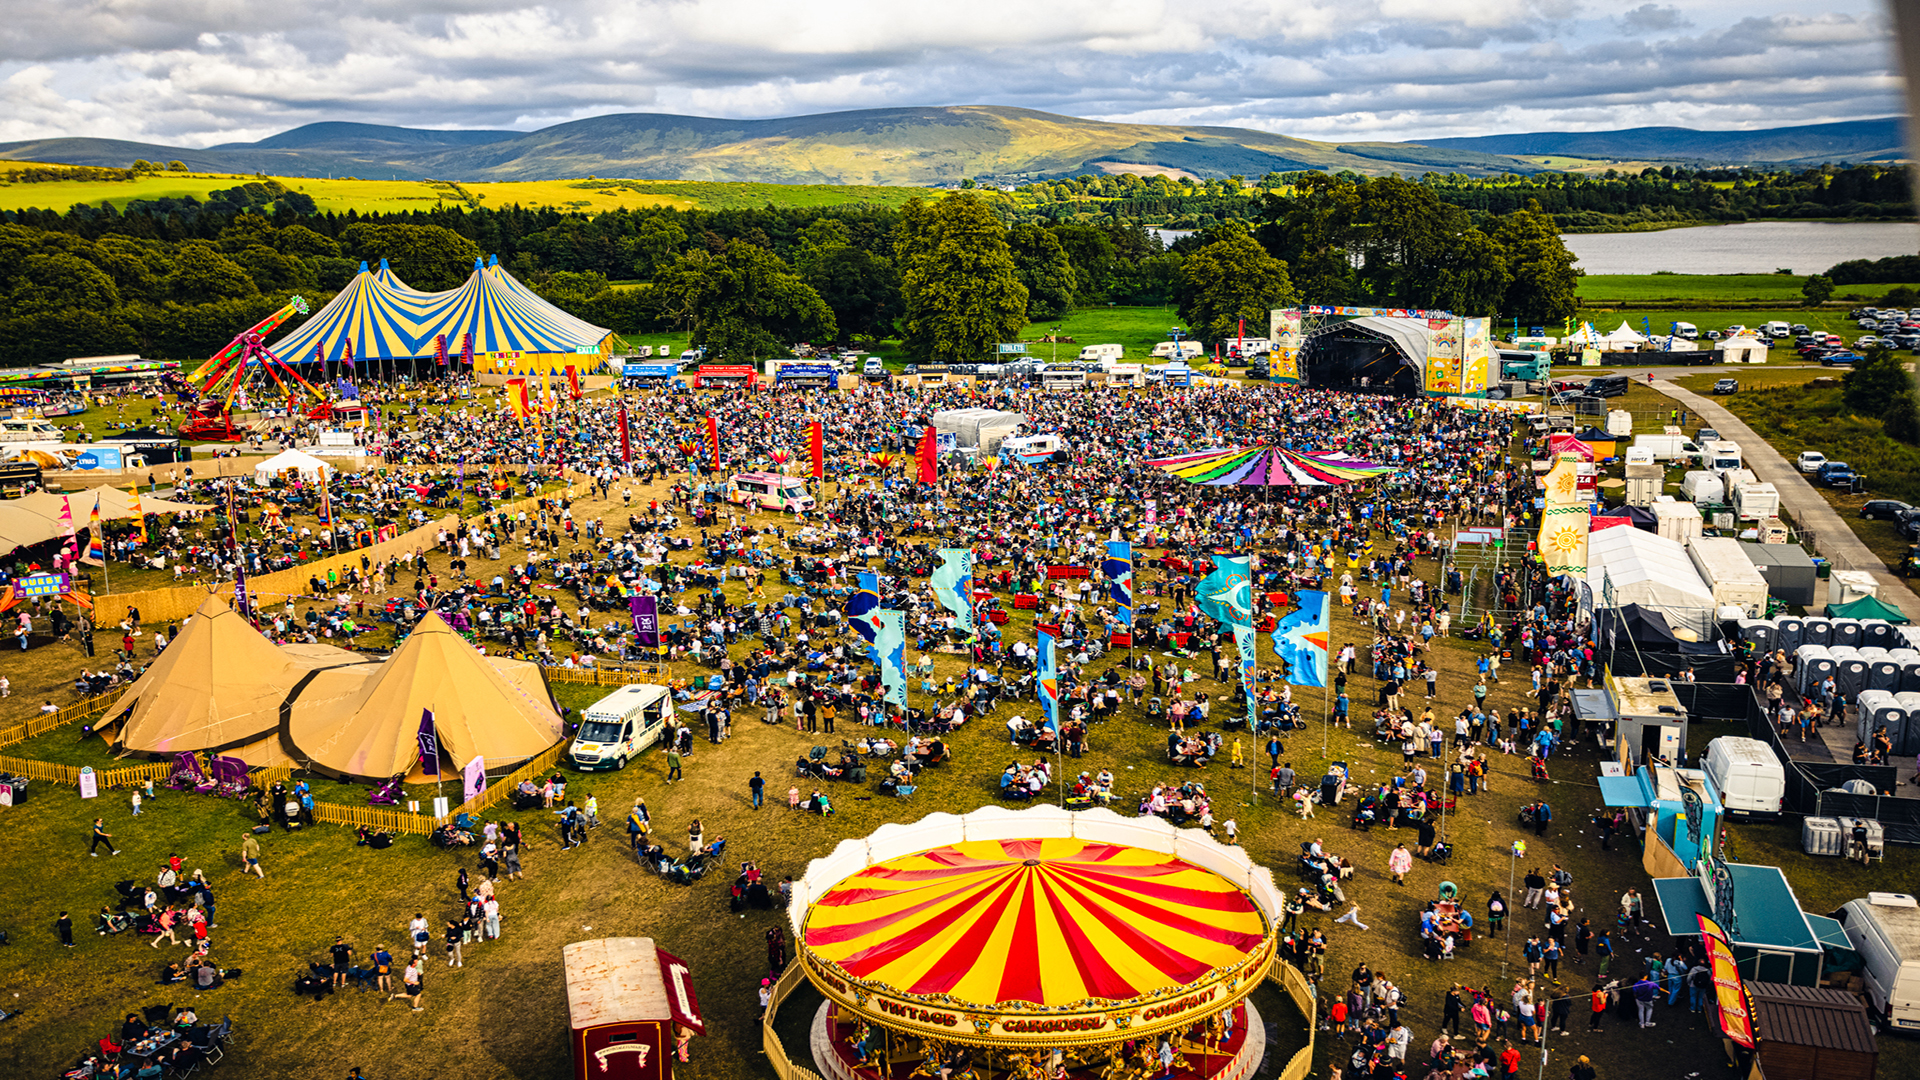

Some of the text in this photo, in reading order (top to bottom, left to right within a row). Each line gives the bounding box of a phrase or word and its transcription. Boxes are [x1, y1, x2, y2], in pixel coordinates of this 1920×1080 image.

[576, 345, 600, 354] EXIT A
[20, 576, 61, 587] GUEST
[26, 585, 60, 595] AREA
[877, 998, 958, 1027] VINTAGE
[1001, 1016, 1107, 1034] CAROUSEL
[1142, 985, 1218, 1022] COMPANY
